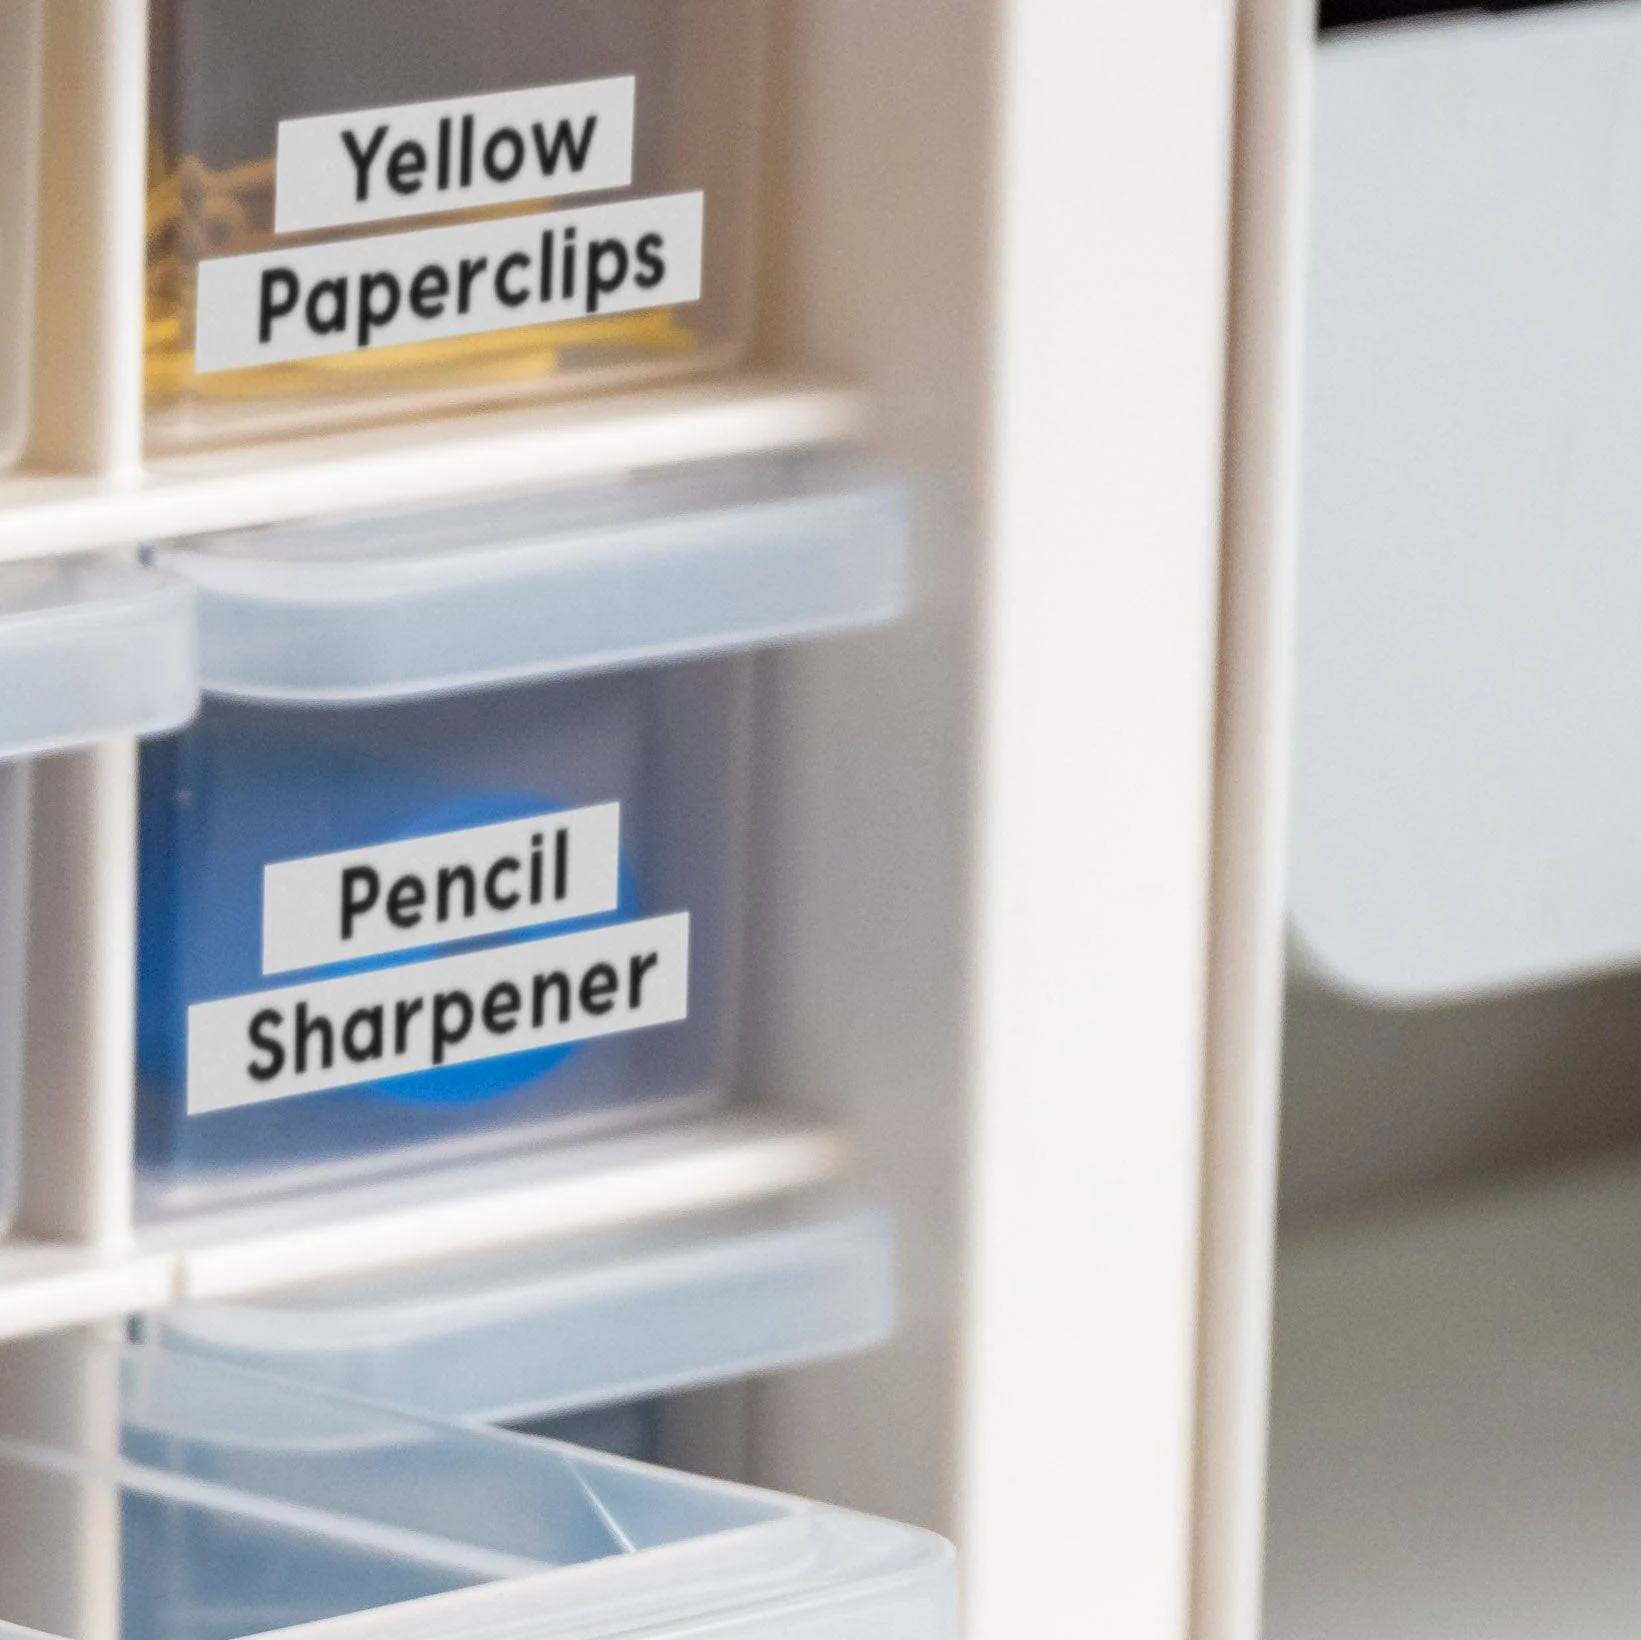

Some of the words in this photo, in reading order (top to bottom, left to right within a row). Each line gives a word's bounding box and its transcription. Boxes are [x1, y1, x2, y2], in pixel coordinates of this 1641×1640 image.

[340, 114, 598, 202] Yellow
[258, 226, 666, 348] Paperclips
[340, 827, 568, 941] Pencil
[247, 951, 658, 1083] Sharpener
